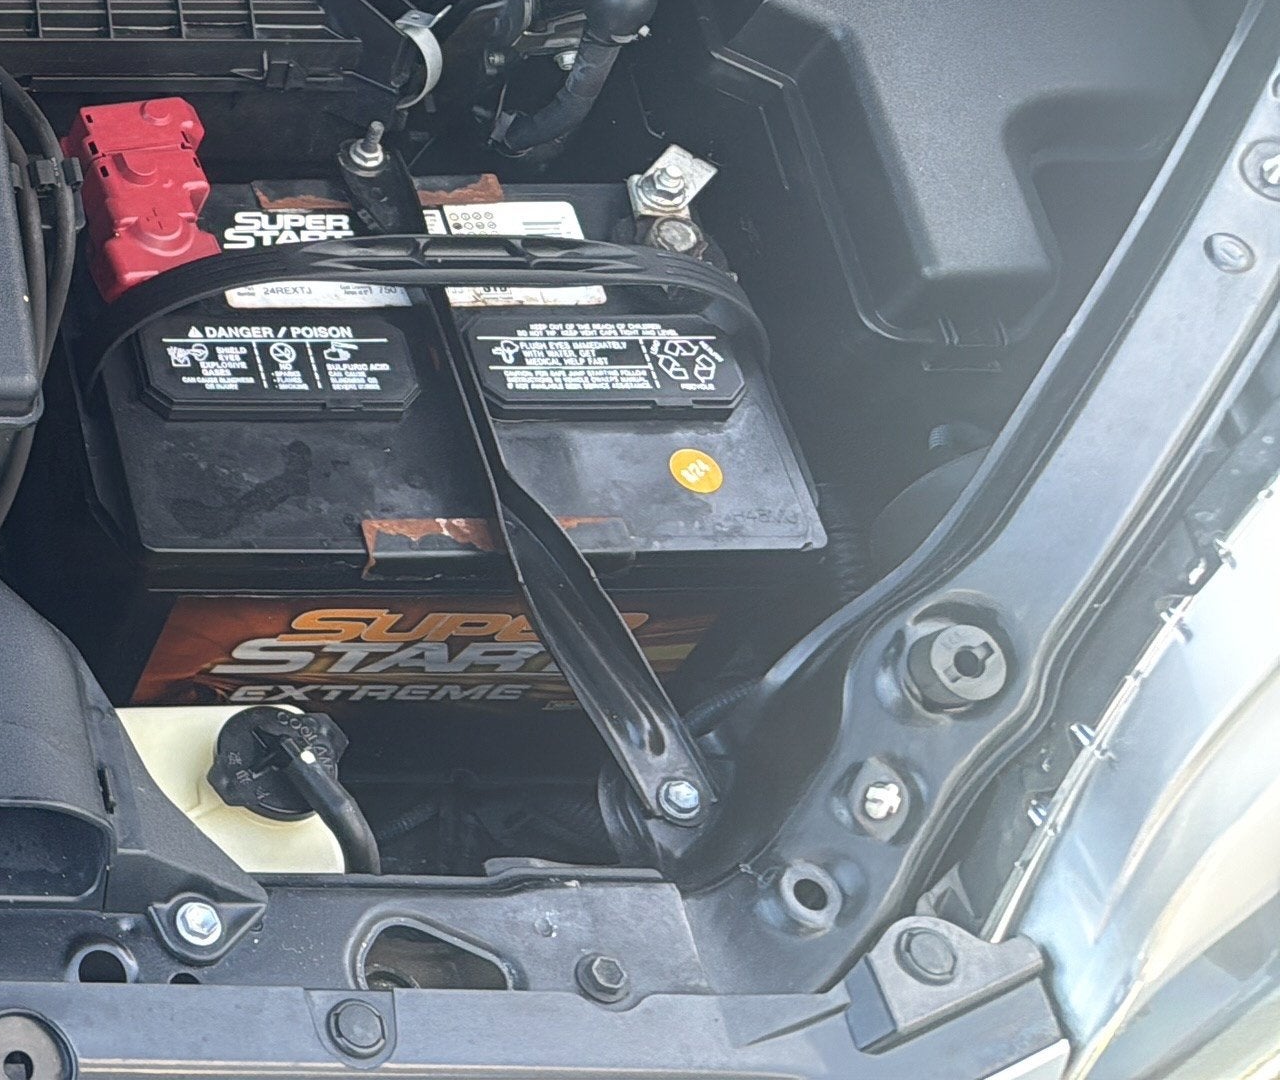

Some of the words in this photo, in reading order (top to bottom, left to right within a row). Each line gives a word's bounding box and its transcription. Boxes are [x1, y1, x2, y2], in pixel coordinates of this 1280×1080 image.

[234, 211, 350, 231] SUPER
[204, 326, 274, 338] DANGER
[290, 326, 354, 338] POISON
[215, 346, 248, 354] SHIELD
[519, 342, 548, 350] FLUSH
[548, 342, 571, 350] EYES
[572, 342, 627, 350] IMMEDIATELY
[521, 349, 545, 358] WITH
[578, 349, 596, 358] GET
[199, 361, 248, 369] EXPLOSIVE
[524, 357, 563, 366] MEDICAL
[562, 357, 586, 366] HELP
[586, 357, 608, 366] FAST
[325, 363, 368, 371] SULFURIC
[209, 637, 561, 673] STAR
[228, 684, 533, 702] EXTREME
